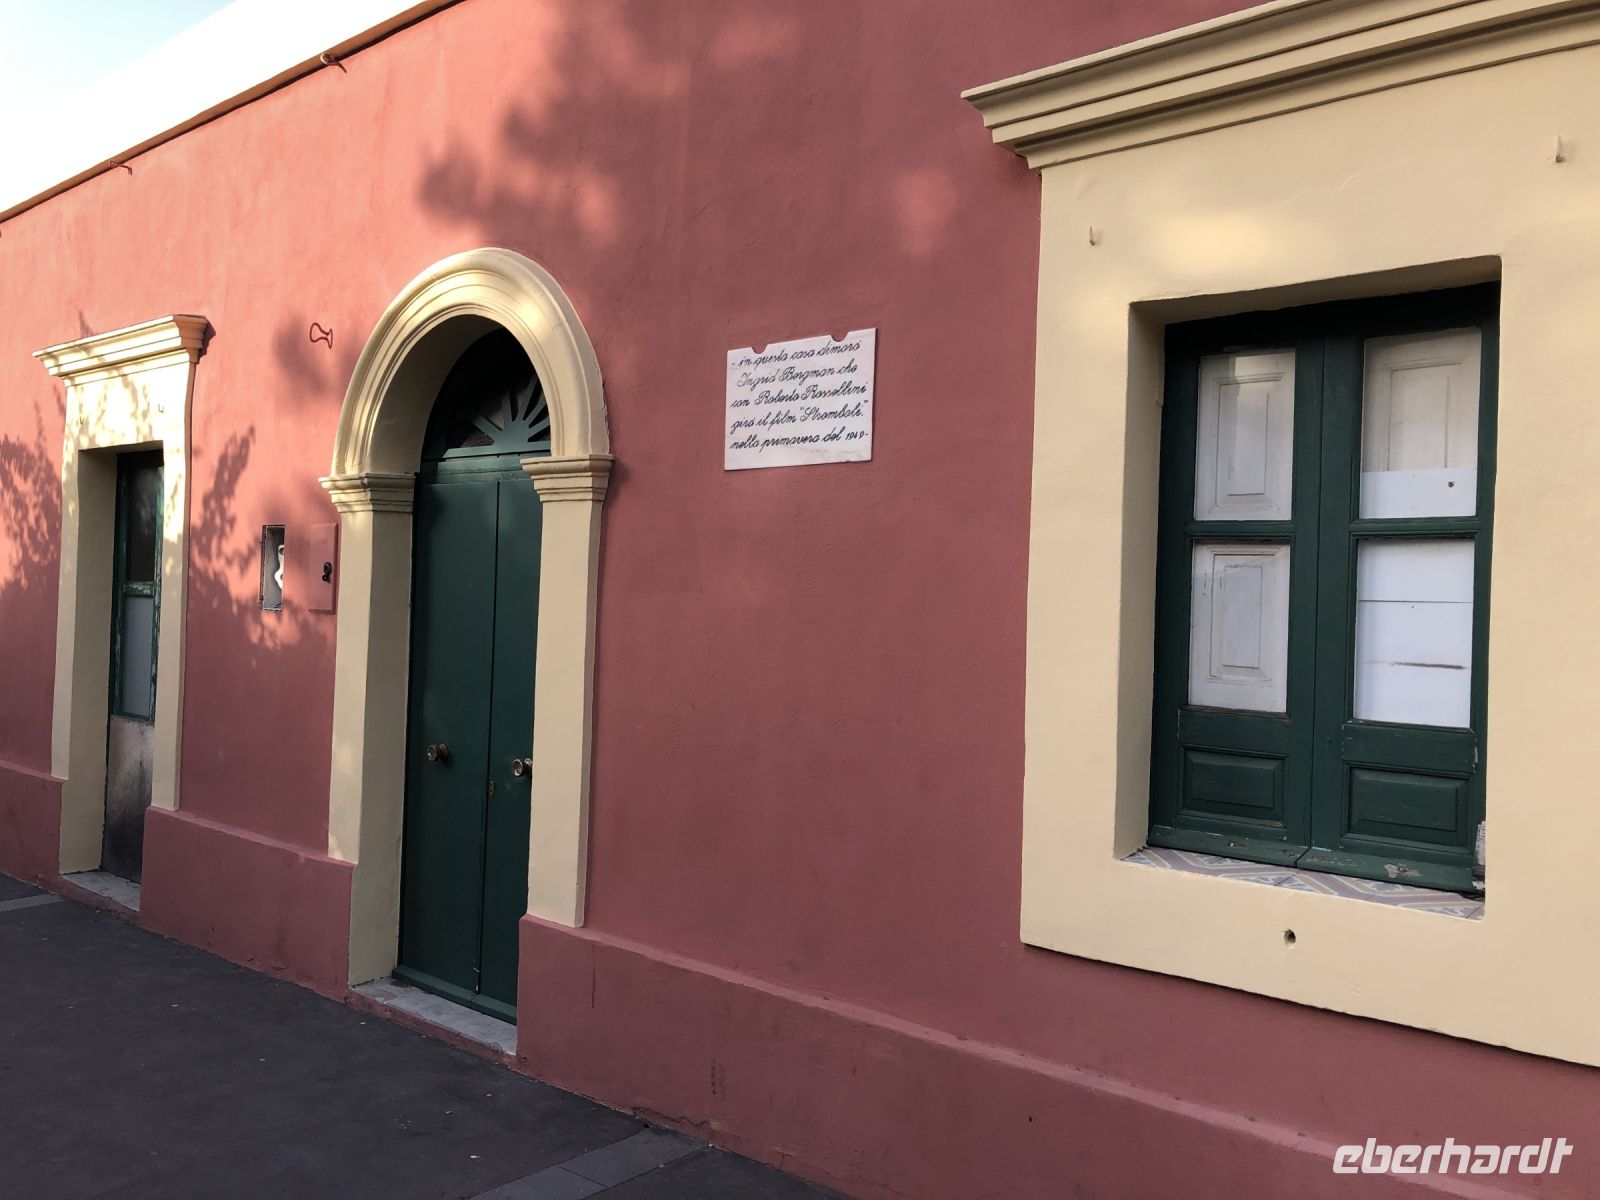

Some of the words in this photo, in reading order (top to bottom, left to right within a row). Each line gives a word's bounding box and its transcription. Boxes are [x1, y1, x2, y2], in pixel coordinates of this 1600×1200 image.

[738, 356, 751, 367] in
[753, 348, 788, 370] questa
[790, 347, 815, 360] casa
[737, 369, 780, 391] Ingrid
[779, 366, 835, 386] Bergman
[836, 358, 858, 375] che
[730, 400, 751, 408] con
[754, 388, 800, 406] Roberto
[801, 380, 869, 400] Rossellini
[756, 411, 771, 427] il
[769, 410, 797, 431] film
[730, 434, 759, 450] nella
[759, 433, 820, 454] primavera
[822, 426, 846, 441] del
